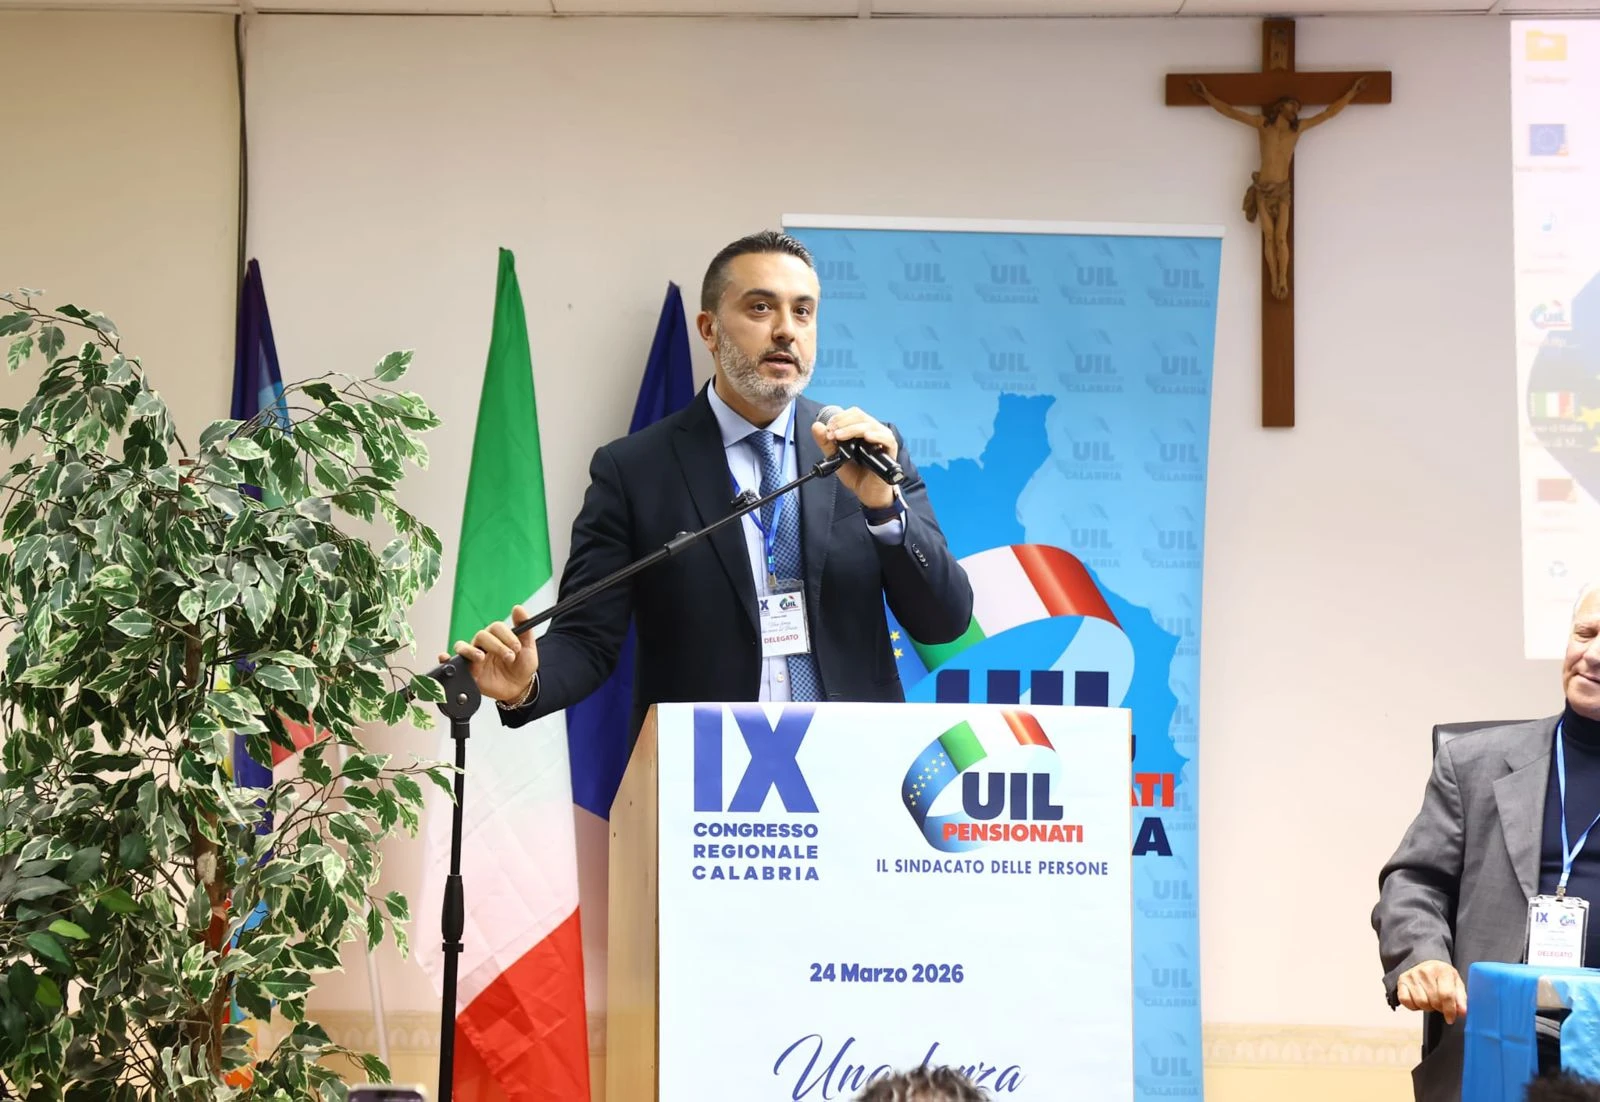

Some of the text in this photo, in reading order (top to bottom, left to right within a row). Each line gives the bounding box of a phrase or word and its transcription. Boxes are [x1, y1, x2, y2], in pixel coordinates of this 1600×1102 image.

[904, 263, 945, 282] UIL
[991, 265, 1031, 284] UIL
[1076, 267, 1117, 287] UIL
[1163, 269, 1204, 288] UIL
[902, 351, 944, 370] UIL
[988, 353, 1029, 372] UIL
[1074, 354, 1117, 374] UIL
[1161, 356, 1202, 375] UIL
[1072, 442, 1115, 461] UIL
[1160, 443, 1199, 463] UIL
[1071, 528, 1112, 549] UIL
[1157, 531, 1197, 550] UIL
[763, 634, 799, 644] DELEGATO
[693, 704, 819, 813] IX
[962, 772, 1064, 821] UIL
[693, 822, 819, 838] CONGRESSO
[942, 823, 1084, 843] PENSIONATI
[693, 844, 819, 860] REGIONALE
[692, 866, 820, 881] CALABRIA
[876, 859, 1109, 876] IL SINDACATO DELLE PERSONE
[1153, 880, 1193, 900] UIL
[810, 963, 964, 983] 24 Marzo 2026
[1151, 968, 1192, 988] UIL
[1151, 1056, 1192, 1076] UIL
